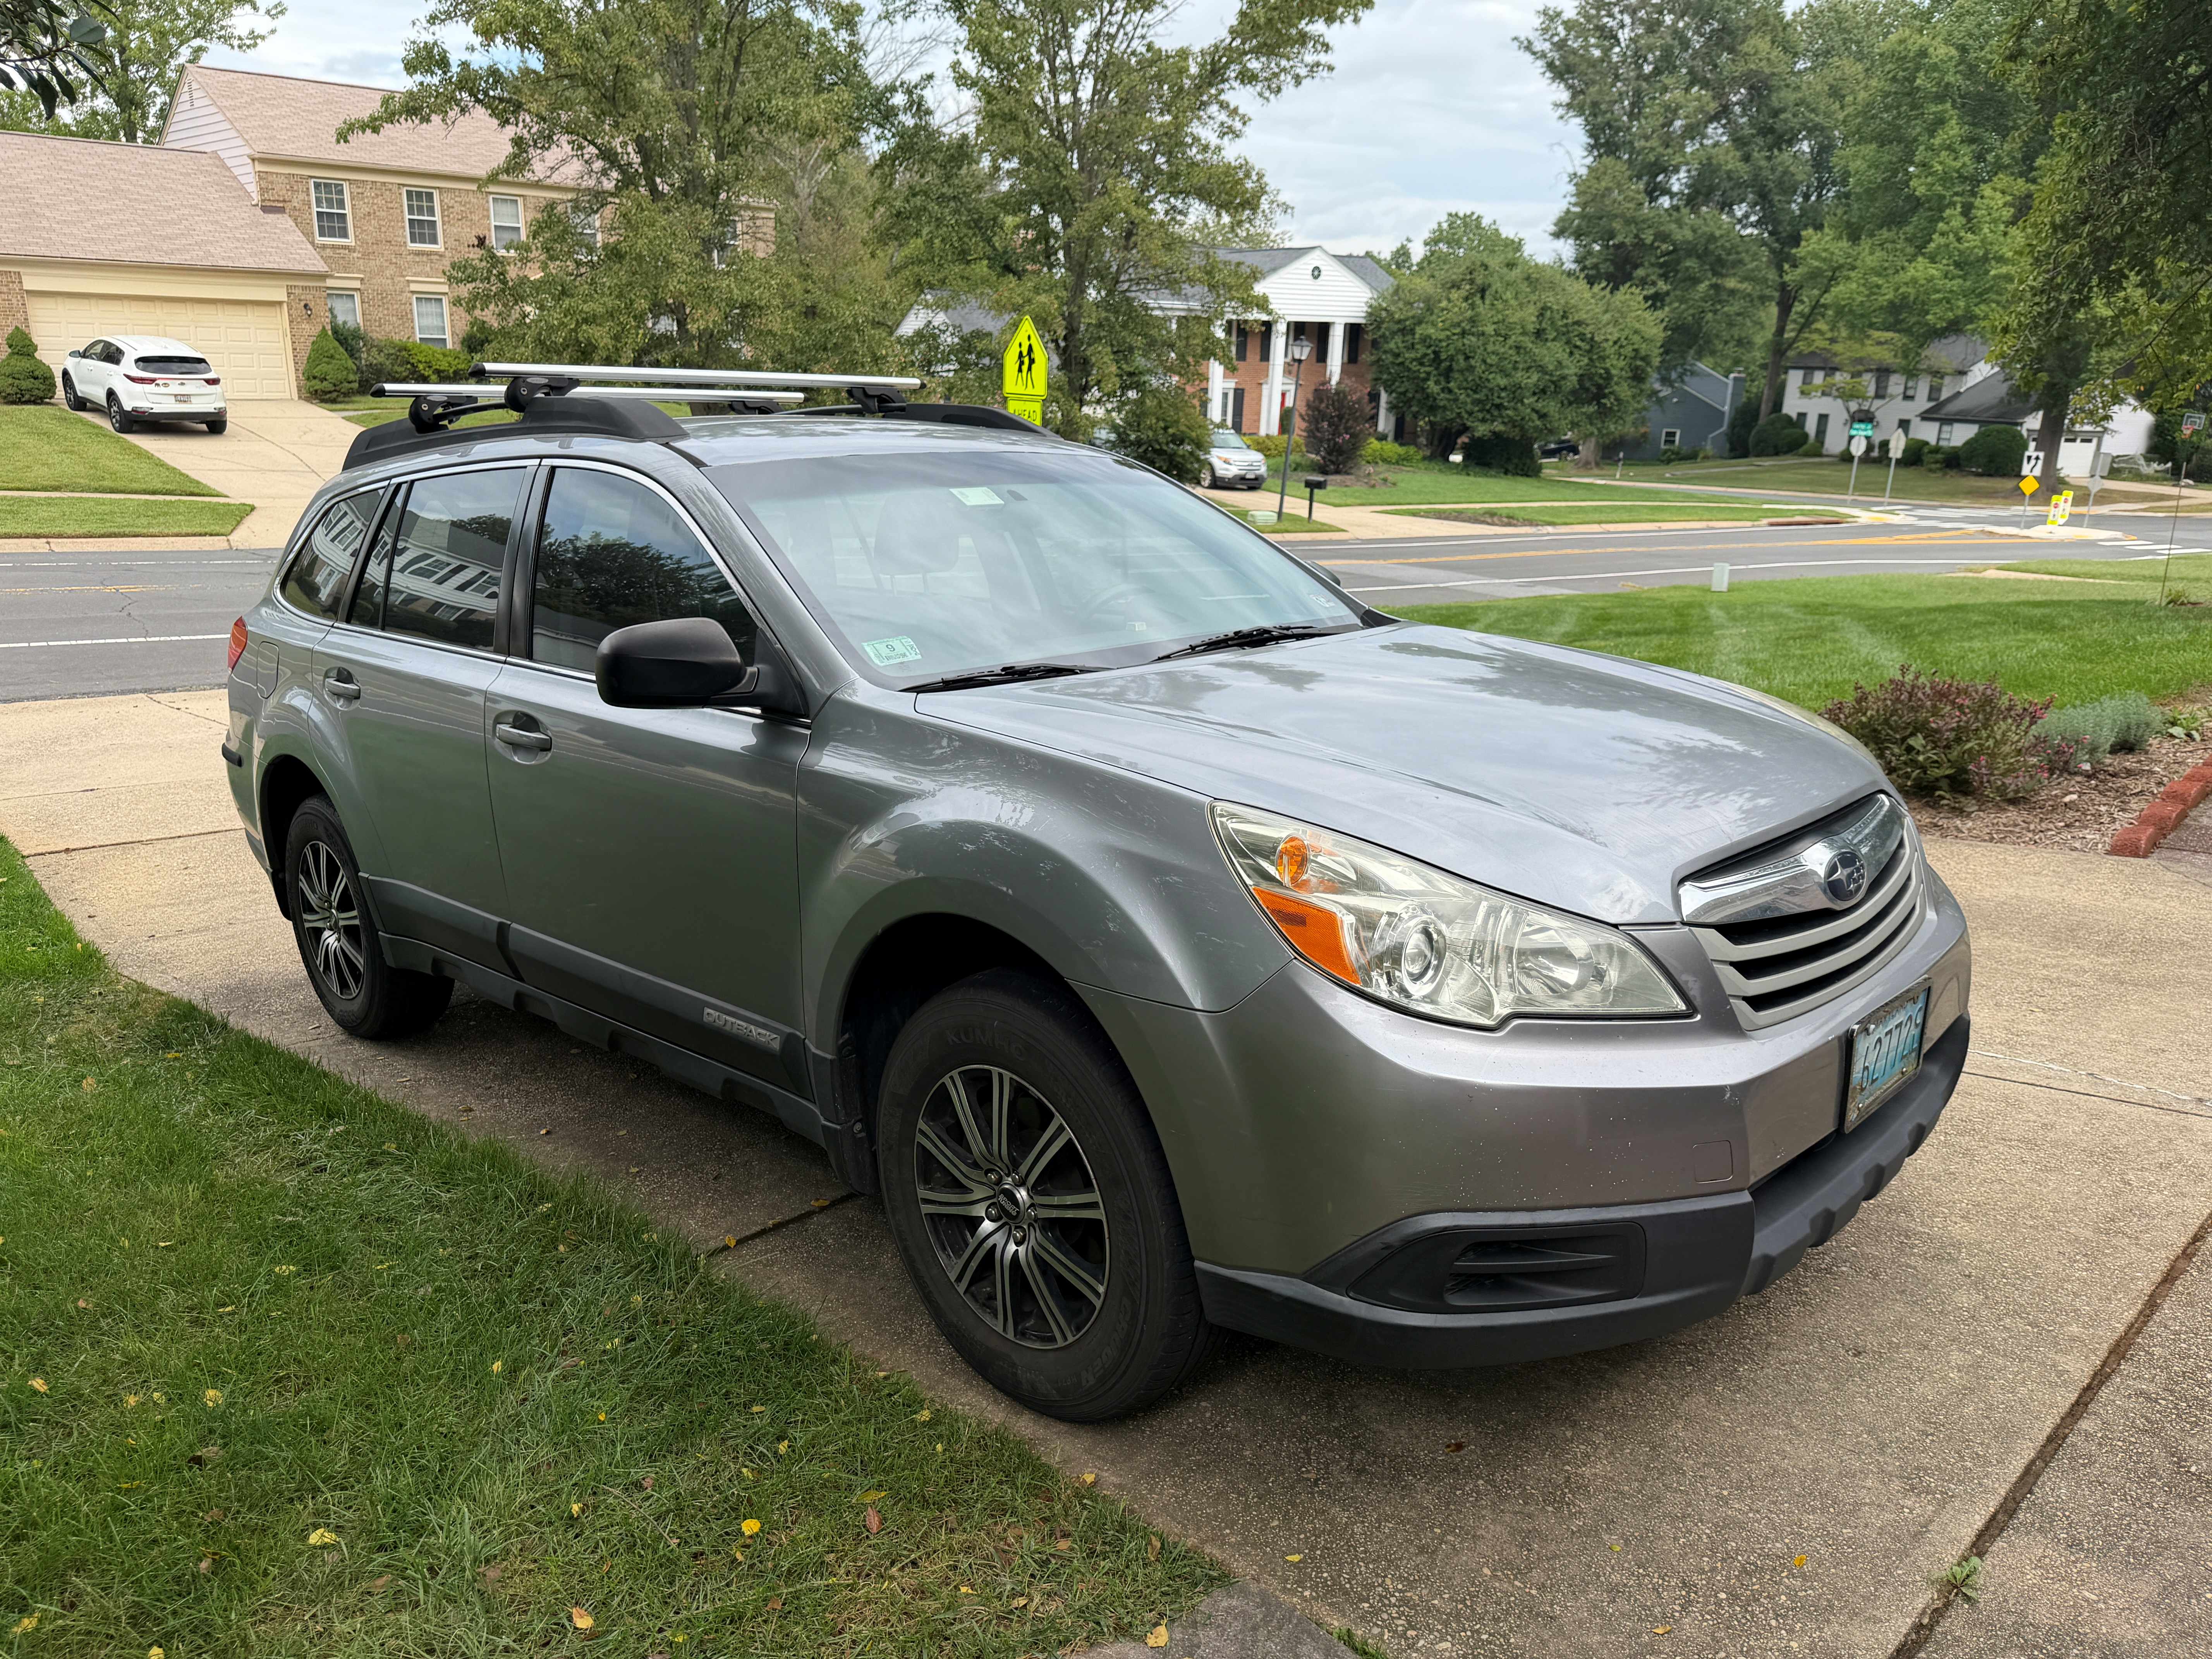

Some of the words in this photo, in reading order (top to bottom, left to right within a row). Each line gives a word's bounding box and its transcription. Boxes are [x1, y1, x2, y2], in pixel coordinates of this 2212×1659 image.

[706, 1009, 780, 1050] OUTBACK
[945, 1027, 1027, 1060] KUMHO
[998, 1198, 1017, 1216] TUNING
[999, 1194, 1020, 1212] SPORT
